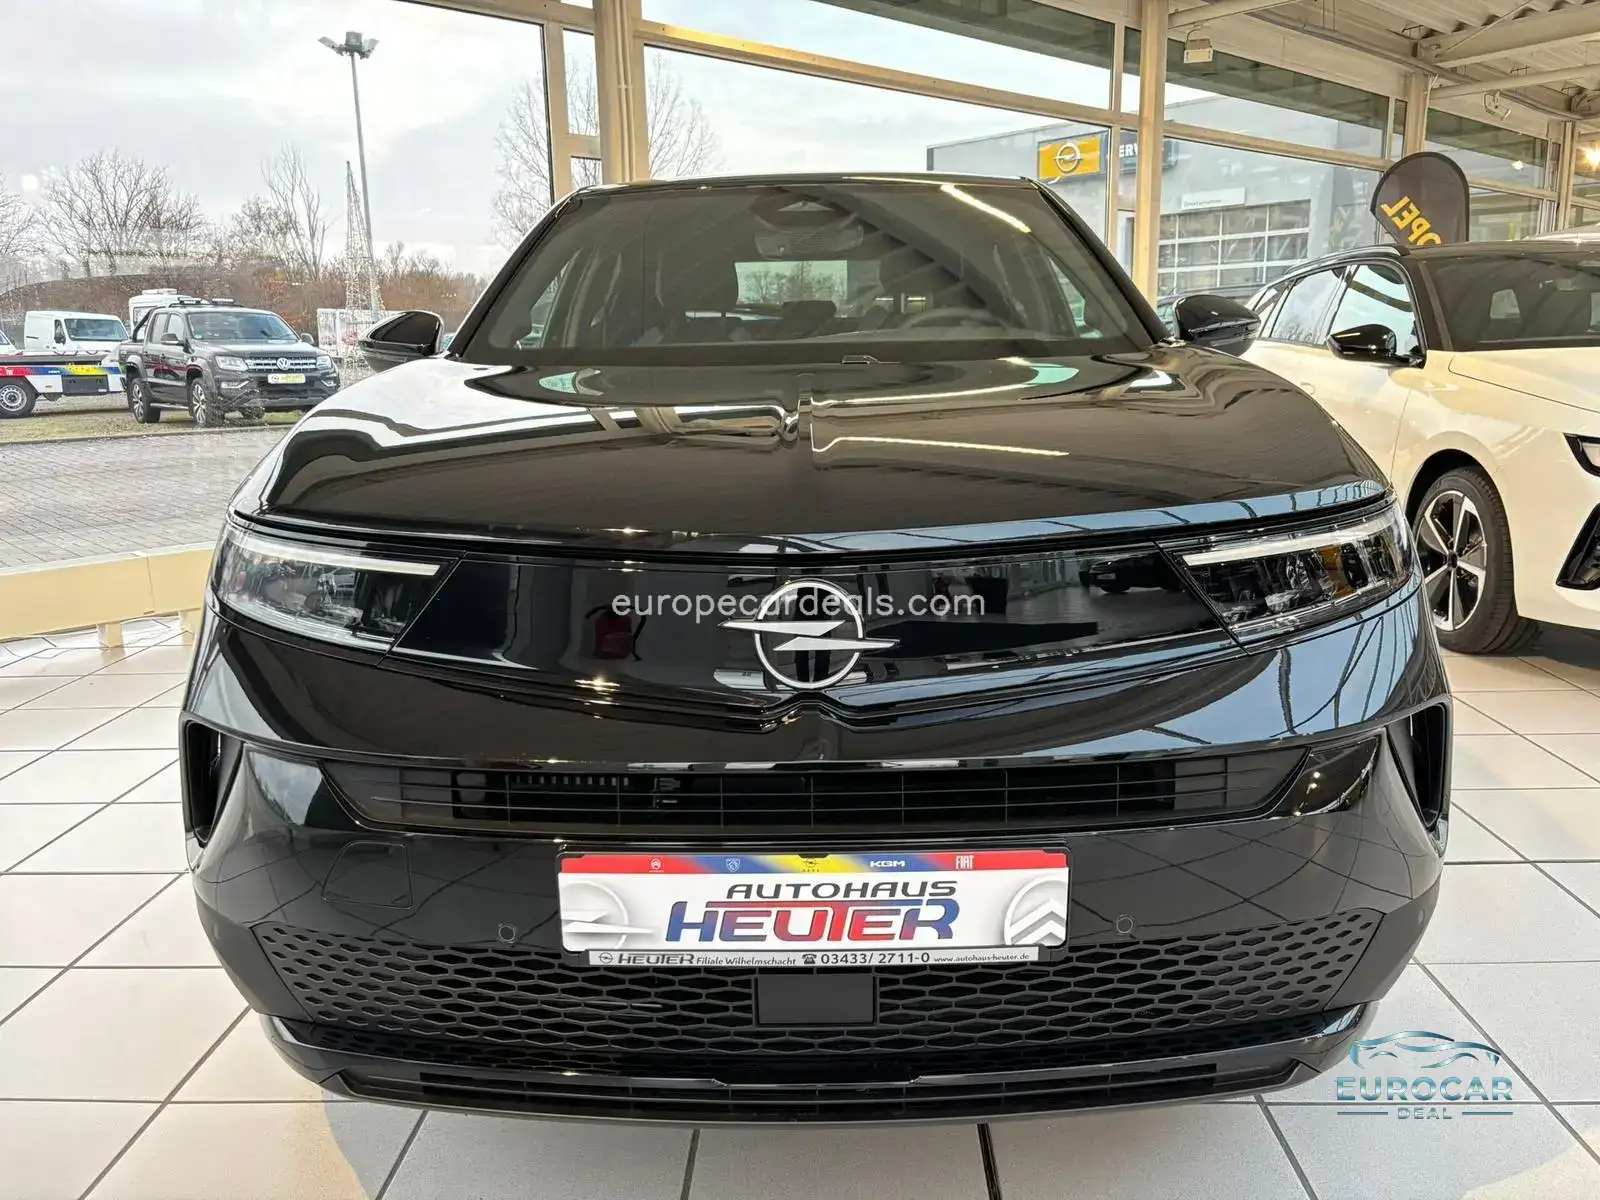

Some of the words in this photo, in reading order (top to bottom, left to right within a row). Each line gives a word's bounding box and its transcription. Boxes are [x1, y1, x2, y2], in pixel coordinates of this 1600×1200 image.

[869, 859, 906, 868] KGM
[955, 855, 975, 870] FIAT
[726, 880, 958, 900] AUTOHAUS
[665, 898, 961, 943] HEUTER
[617, 952, 695, 965] HEUTER
[696, 956, 724, 966] Filiale
[725, 956, 797, 966] Wilhelmschacht
[820, 952, 874, 965] 03433/
[878, 951, 931, 965] 2711-0
[933, 952, 1031, 963] www.autohaus-heuter.de
